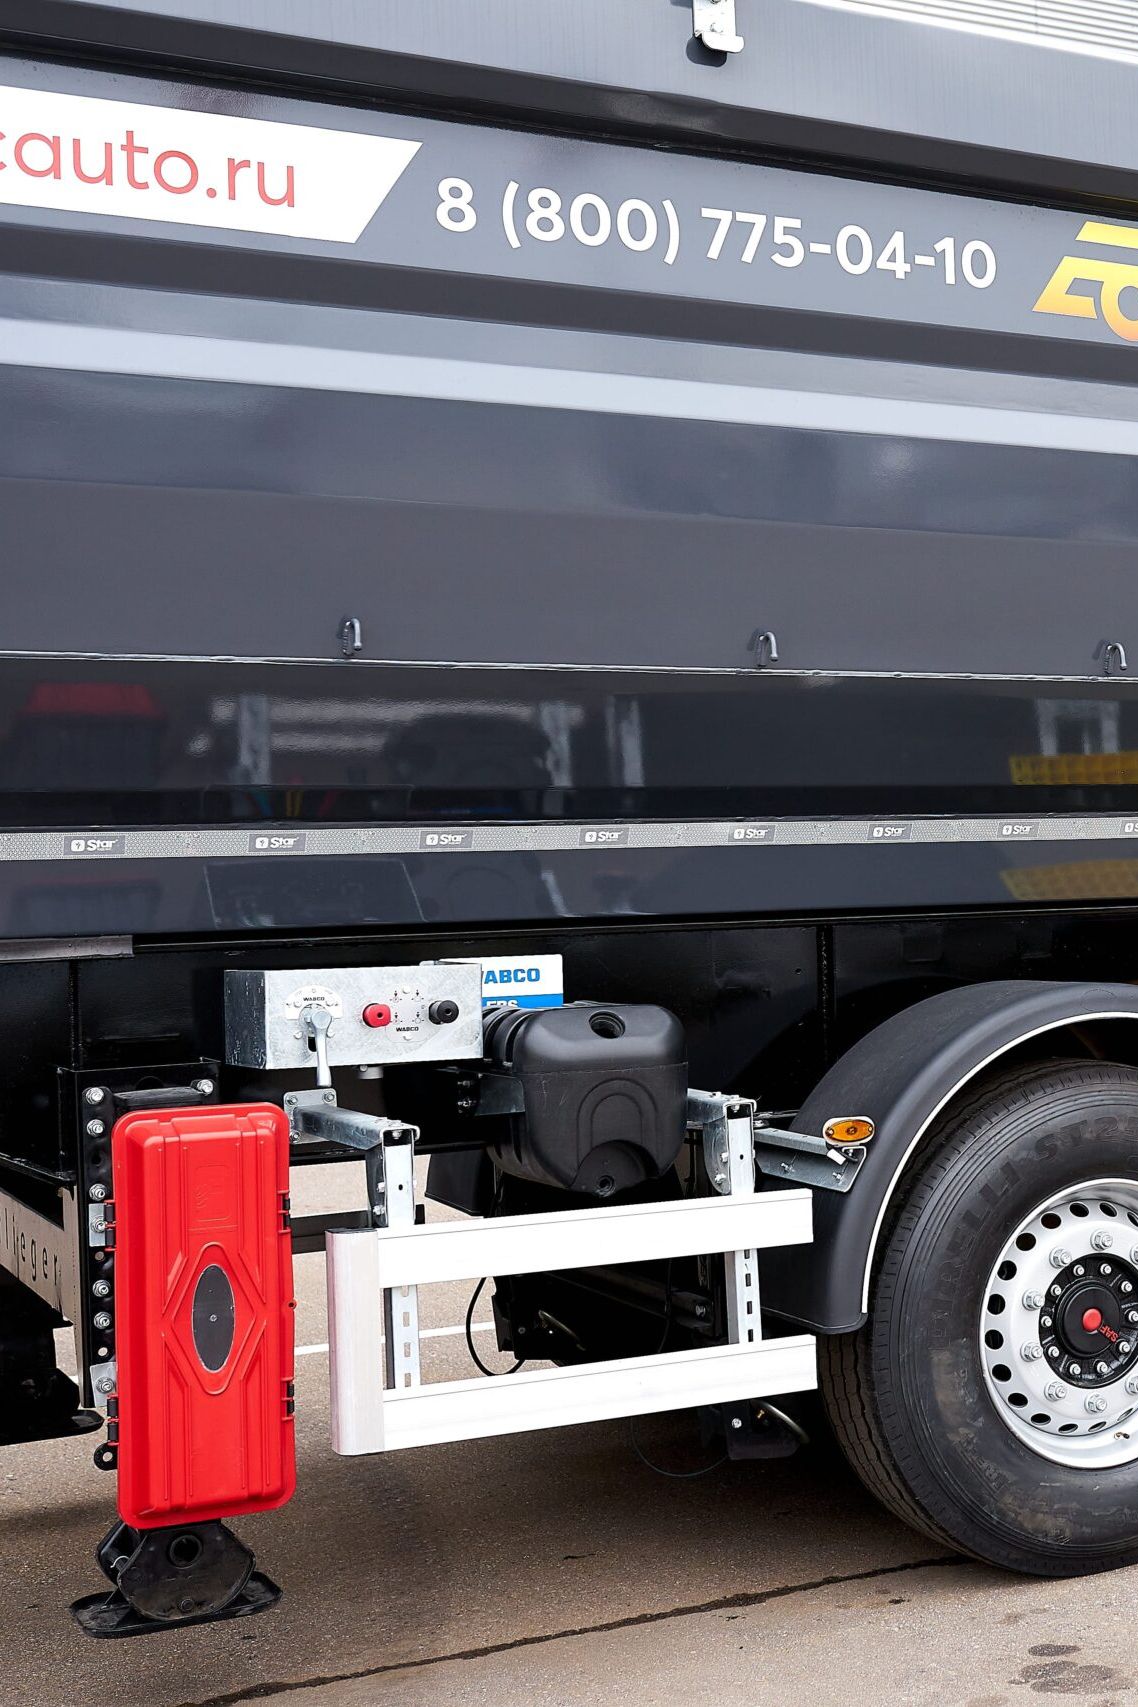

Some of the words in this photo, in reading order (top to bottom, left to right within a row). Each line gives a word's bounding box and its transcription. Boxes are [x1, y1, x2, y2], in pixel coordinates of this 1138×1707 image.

[0, 131, 296, 208] auto.ru
[435, 177, 478, 233] 8
[502, 180, 680, 266] (800)
[700, 207, 998, 289] 775-04-10
[481, 968, 540, 984] ABCO
[1100, 1324, 1119, 1343] SAF
